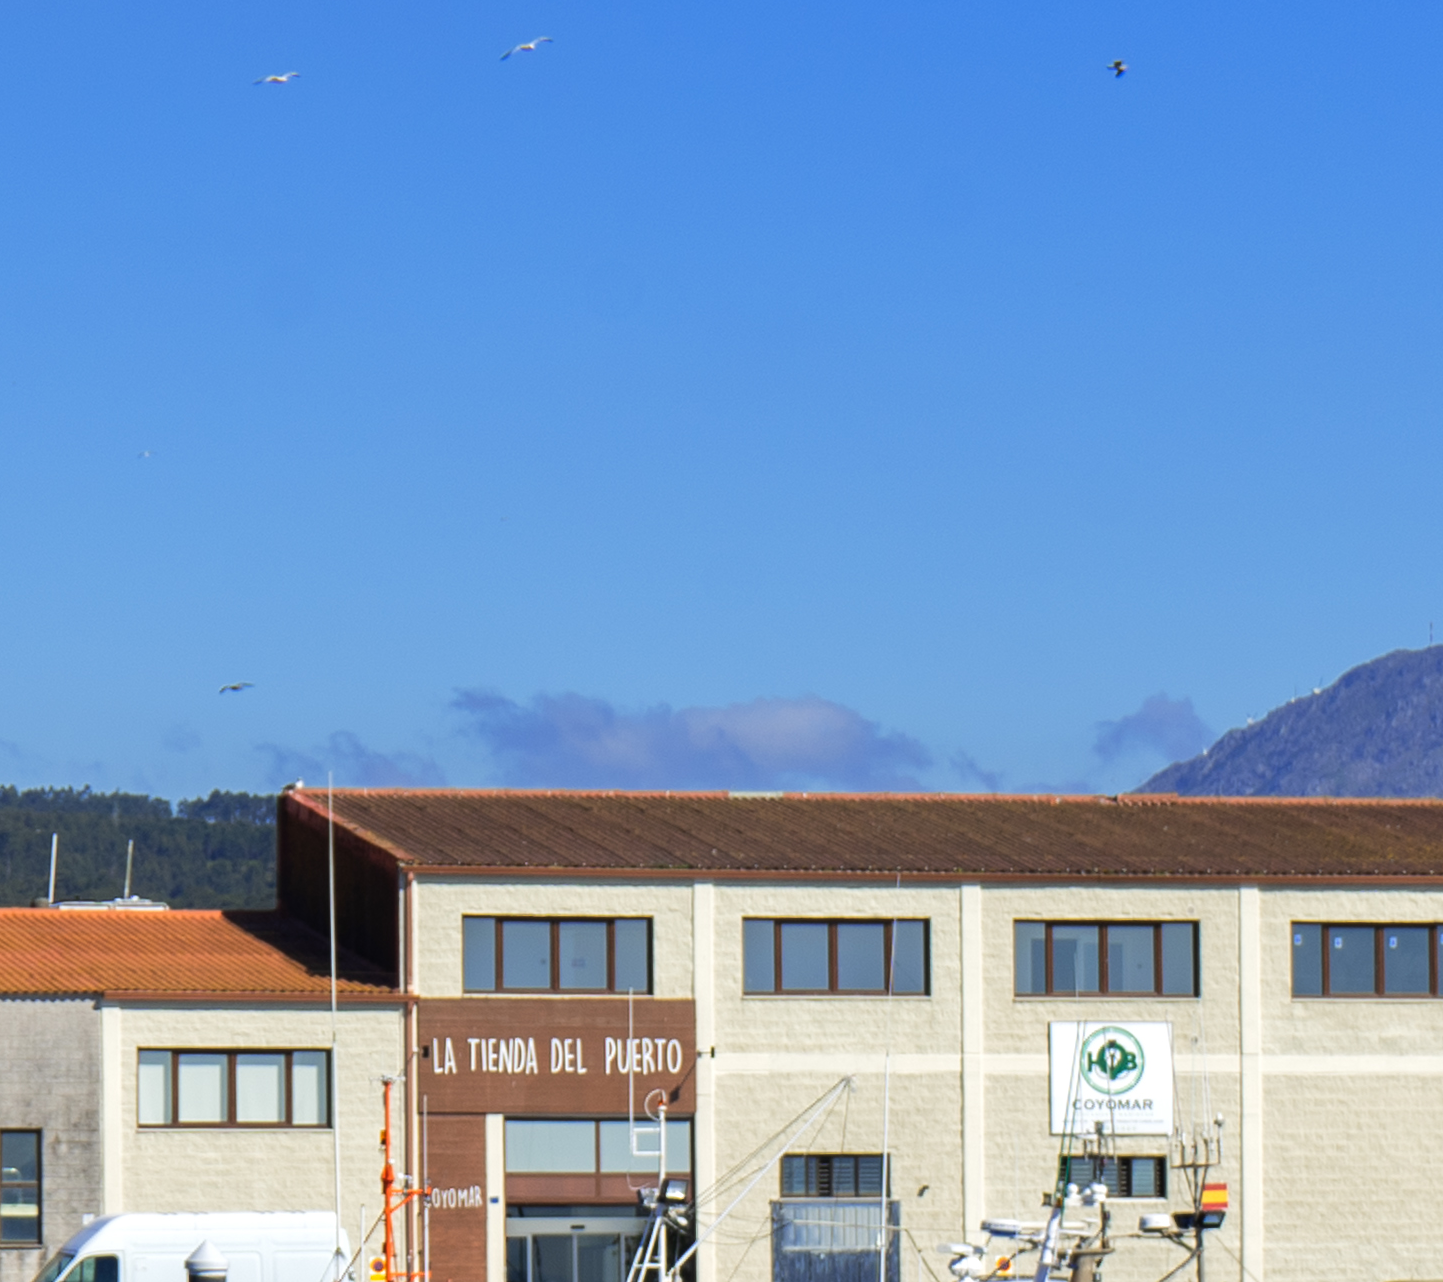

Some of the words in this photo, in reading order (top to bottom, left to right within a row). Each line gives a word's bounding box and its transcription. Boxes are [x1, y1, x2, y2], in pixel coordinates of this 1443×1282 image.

[432, 1037, 457, 1075] LA
[467, 1037, 538, 1075] TIENDA
[550, 1037, 587, 1074] DEL
[605, 1036, 682, 1075] PUERTO
[1073, 1098, 1153, 1110] COYOMAR
[426, 1185, 483, 1208] OYOMAR
